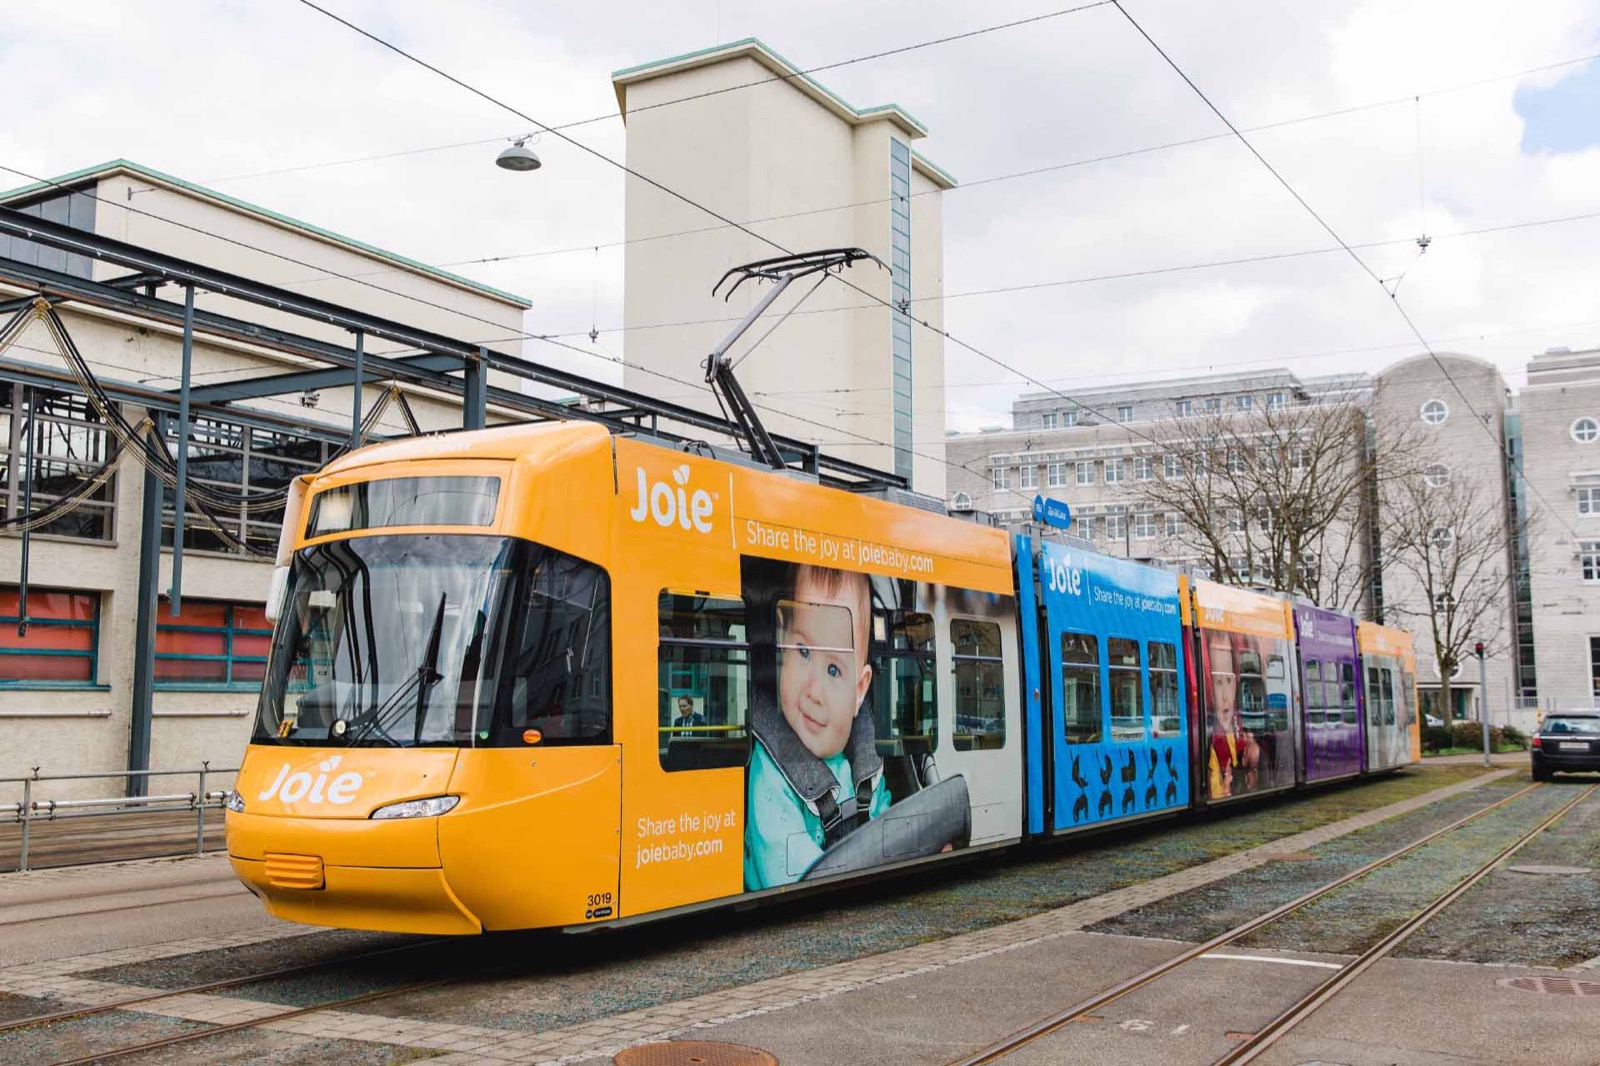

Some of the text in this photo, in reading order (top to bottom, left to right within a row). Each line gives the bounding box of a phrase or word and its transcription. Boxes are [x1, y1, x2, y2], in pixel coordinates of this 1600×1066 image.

[630, 464, 713, 534] Joie
[747, 520, 934, 573] Share the joy at joiebaby.com
[1049, 554, 1081, 596] Joie
[1094, 586, 1112, 604] Share
[1113, 591, 1124, 605] the
[258, 755, 363, 805] Joie
[637, 809, 736, 838] Share the joy at
[635, 839, 723, 870] joiebaby.com
[587, 892, 612, 907] 3019
